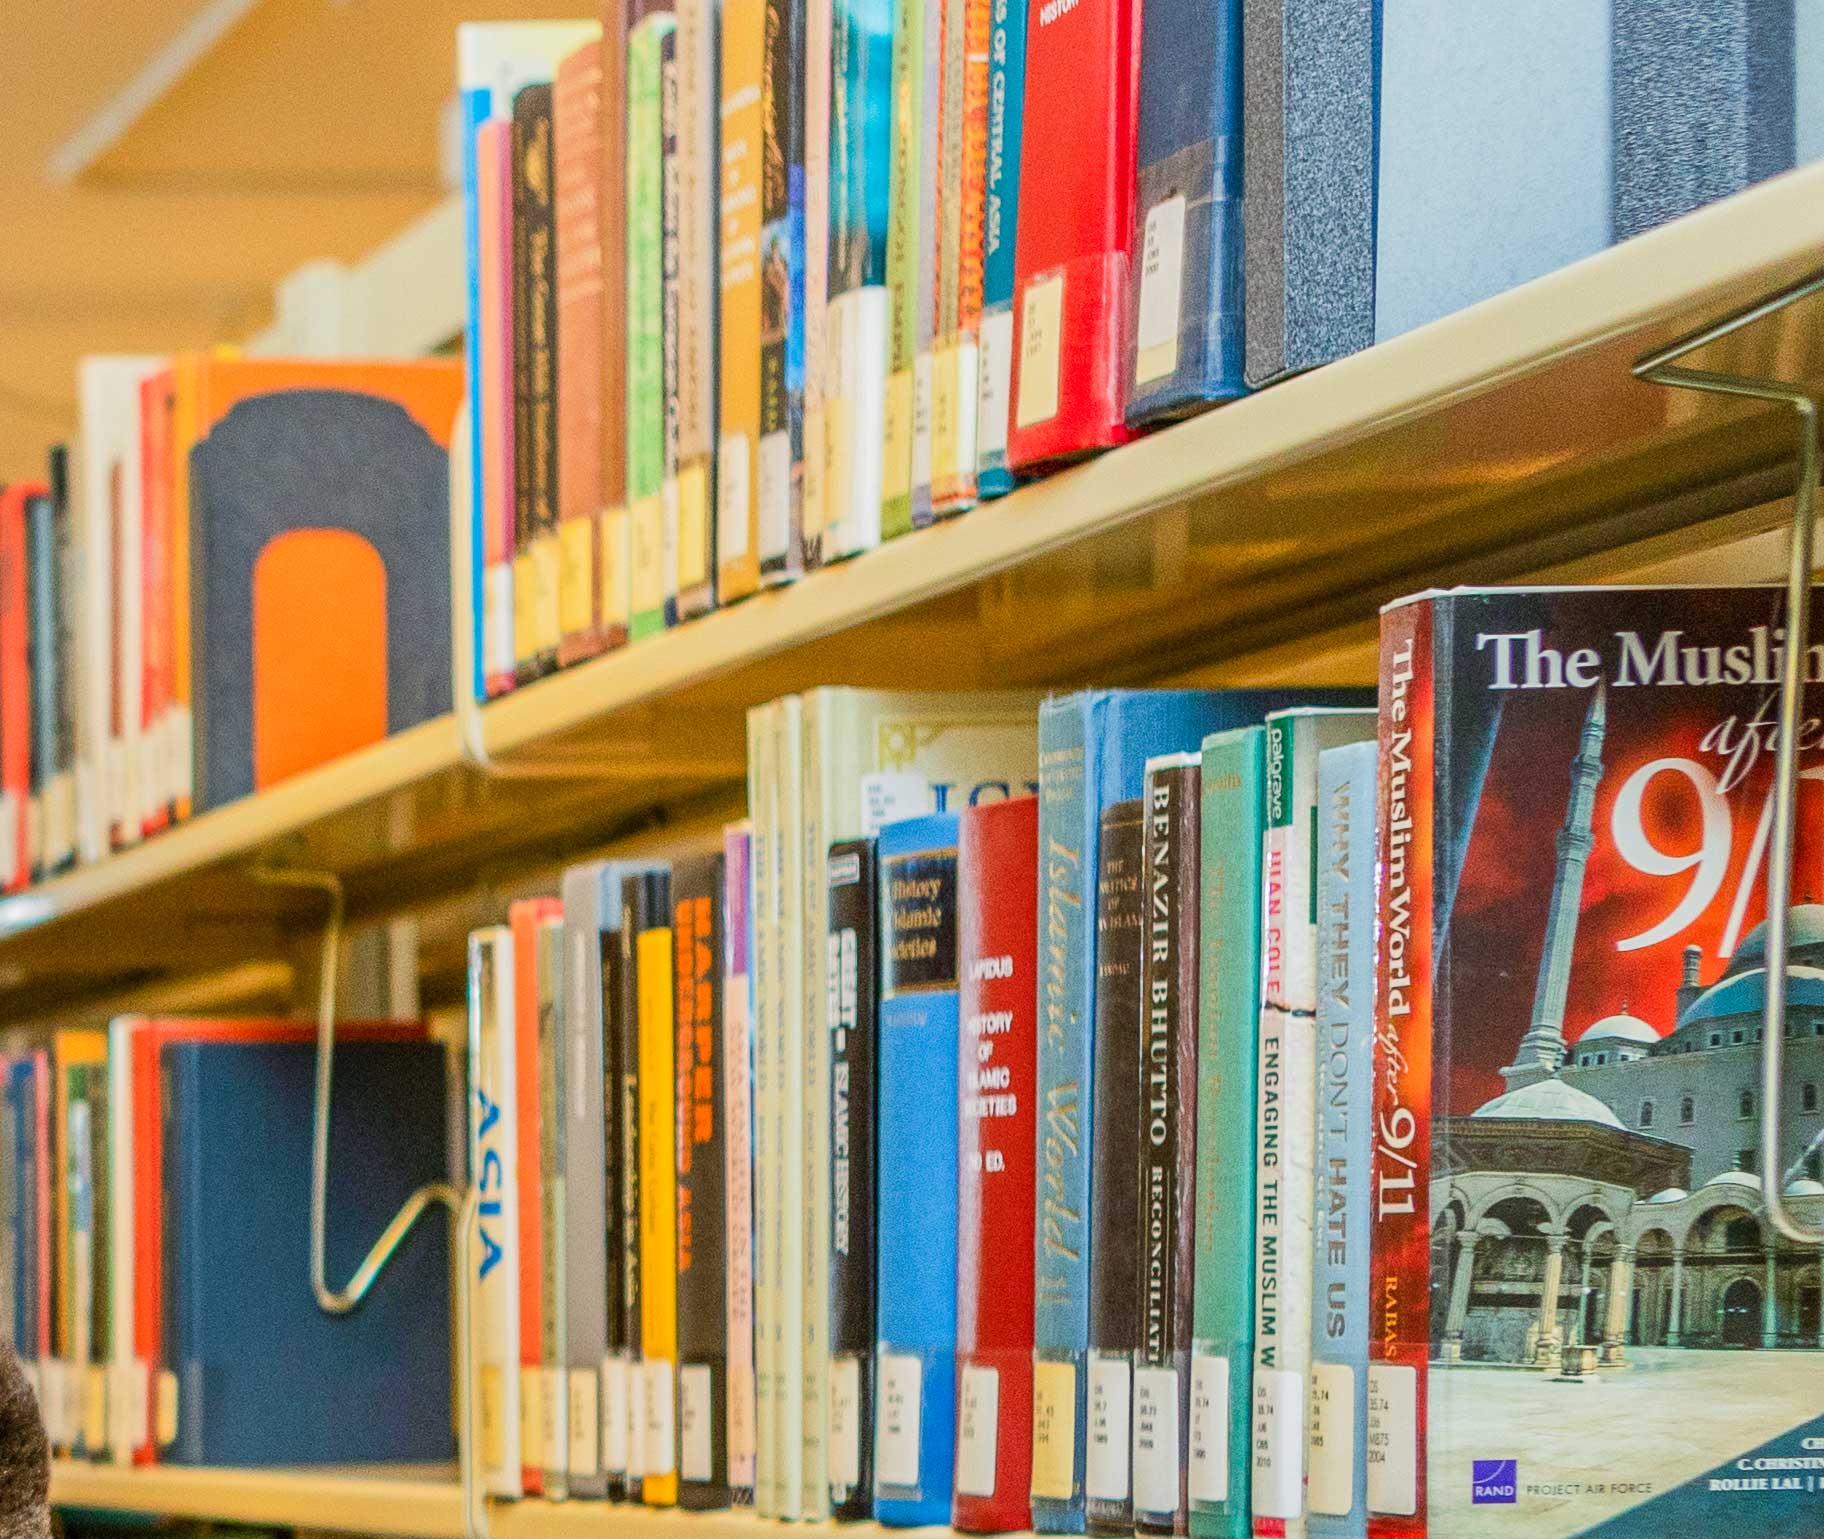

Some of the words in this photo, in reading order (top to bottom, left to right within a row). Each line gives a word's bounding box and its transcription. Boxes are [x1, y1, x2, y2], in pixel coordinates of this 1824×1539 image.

[989, 70, 1007, 180] CENTRAL
[985, 192, 1001, 255] ASIA
[1391, 637, 1415, 719] The
[1475, 628, 1601, 691] The
[1269, 726, 1282, 821] palgrave
[1388, 727, 1413, 897] Muslim
[1152, 784, 1171, 964] BENAZIR
[1331, 780, 1351, 883] WHY
[1330, 893, 1351, 1010] THEY
[1387, 898, 1412, 1019] World
[1150, 979, 1170, 1146] BHUTTO
[1263, 1036, 1280, 1168] ENGAGING
[1328, 1022, 1350, 1144] DON'T
[1378, 1023, 1409, 1116] after
[476, 1085, 505, 1285] ASIA
[1262, 1179, 1278, 1226] THE
[1327, 1157, 1348, 1267] HATE
[1378, 1106, 1418, 1223] 9/11
[1149, 1165, 1164, 1366] RECONCILIATI
[1260, 1233, 1278, 1337] MUSLIM
[1326, 1281, 1347, 1340] US
[1474, 1484, 1516, 1499] RAND
[1527, 1482, 1582, 1496] PROJECT
[1586, 1482, 1608, 1496] AIR
[1611, 1482, 1653, 1496] FORCE
[1708, 1477, 1769, 1492] ROLLIE
[1771, 1477, 1803, 1491] LAL
